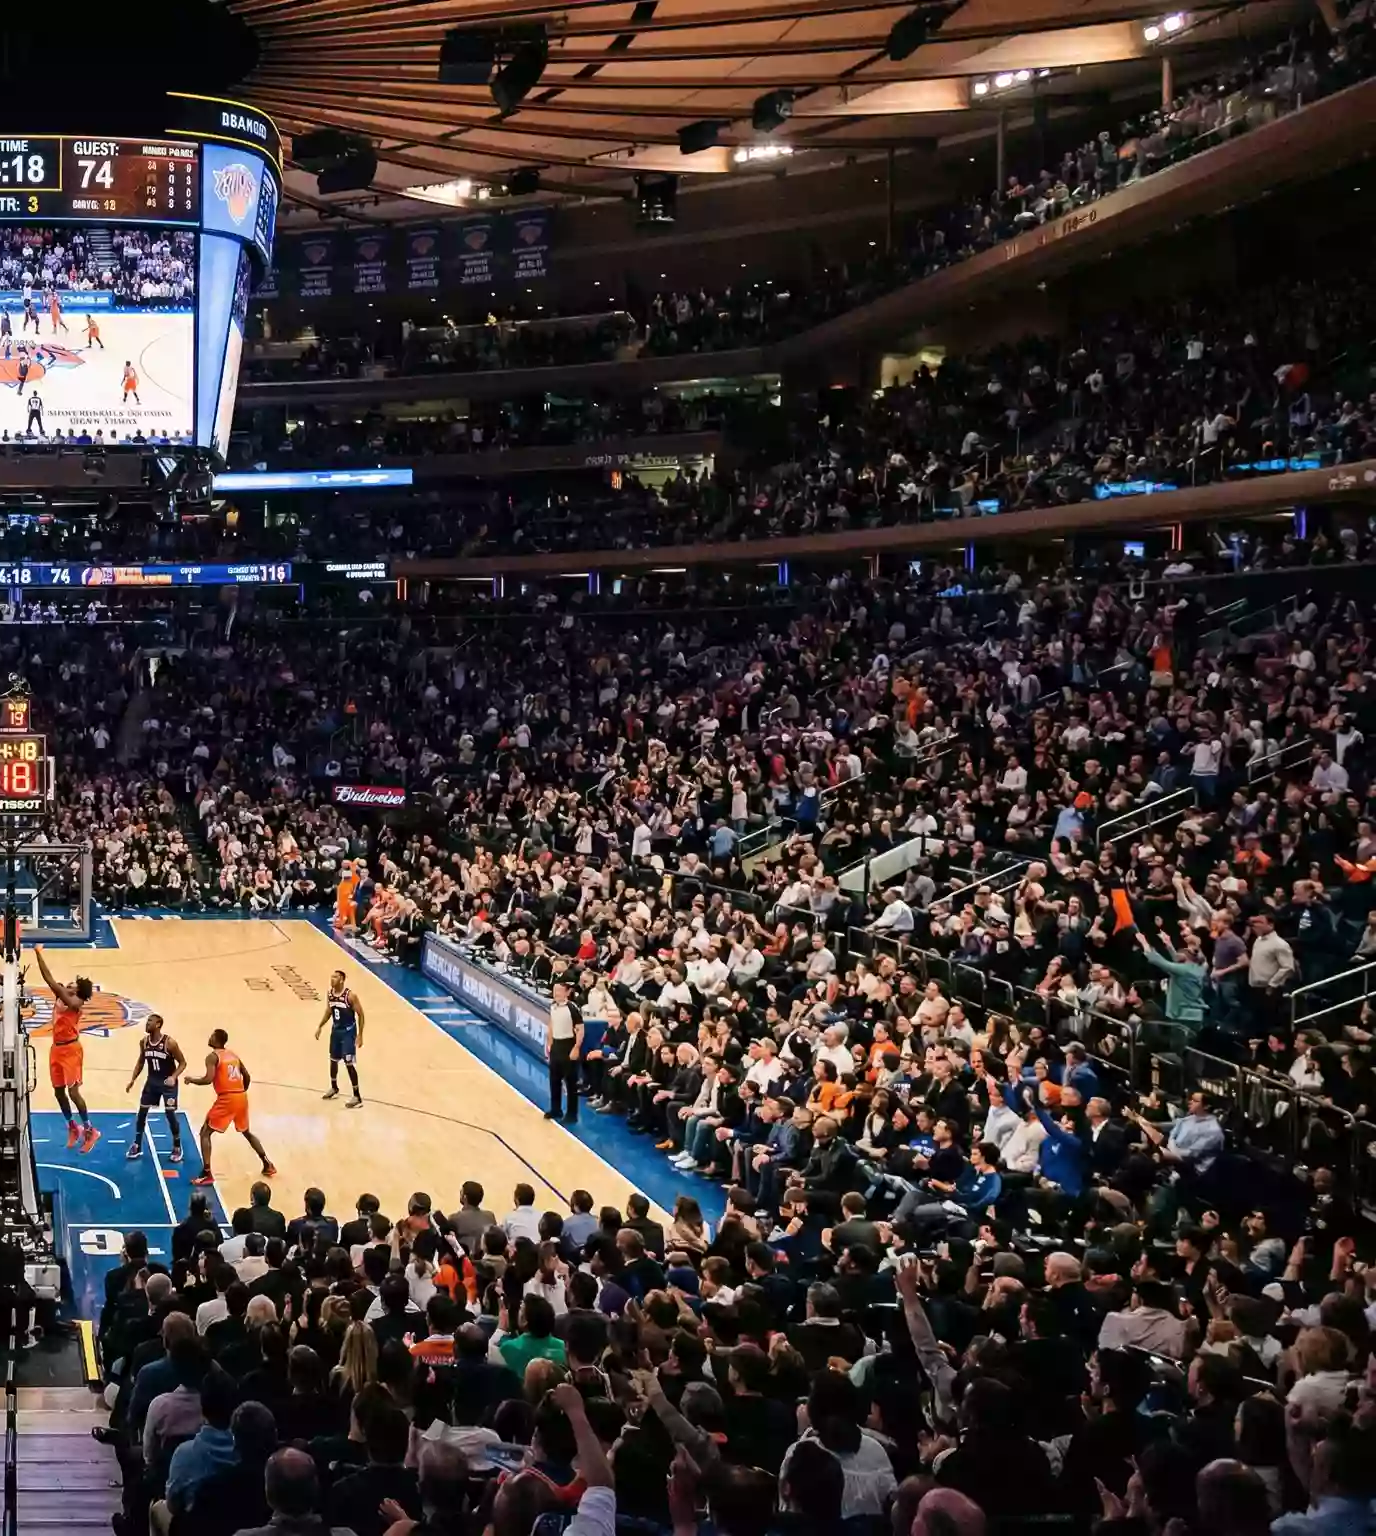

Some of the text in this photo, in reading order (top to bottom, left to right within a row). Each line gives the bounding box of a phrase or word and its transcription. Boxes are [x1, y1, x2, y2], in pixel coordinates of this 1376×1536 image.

[73, 141, 120, 156] GUEST:
[78, 160, 114, 189] 74
[27, 196, 39, 213] 3
[3, 762, 30, 793] 18
[335, 786, 406, 805] Budweiser
